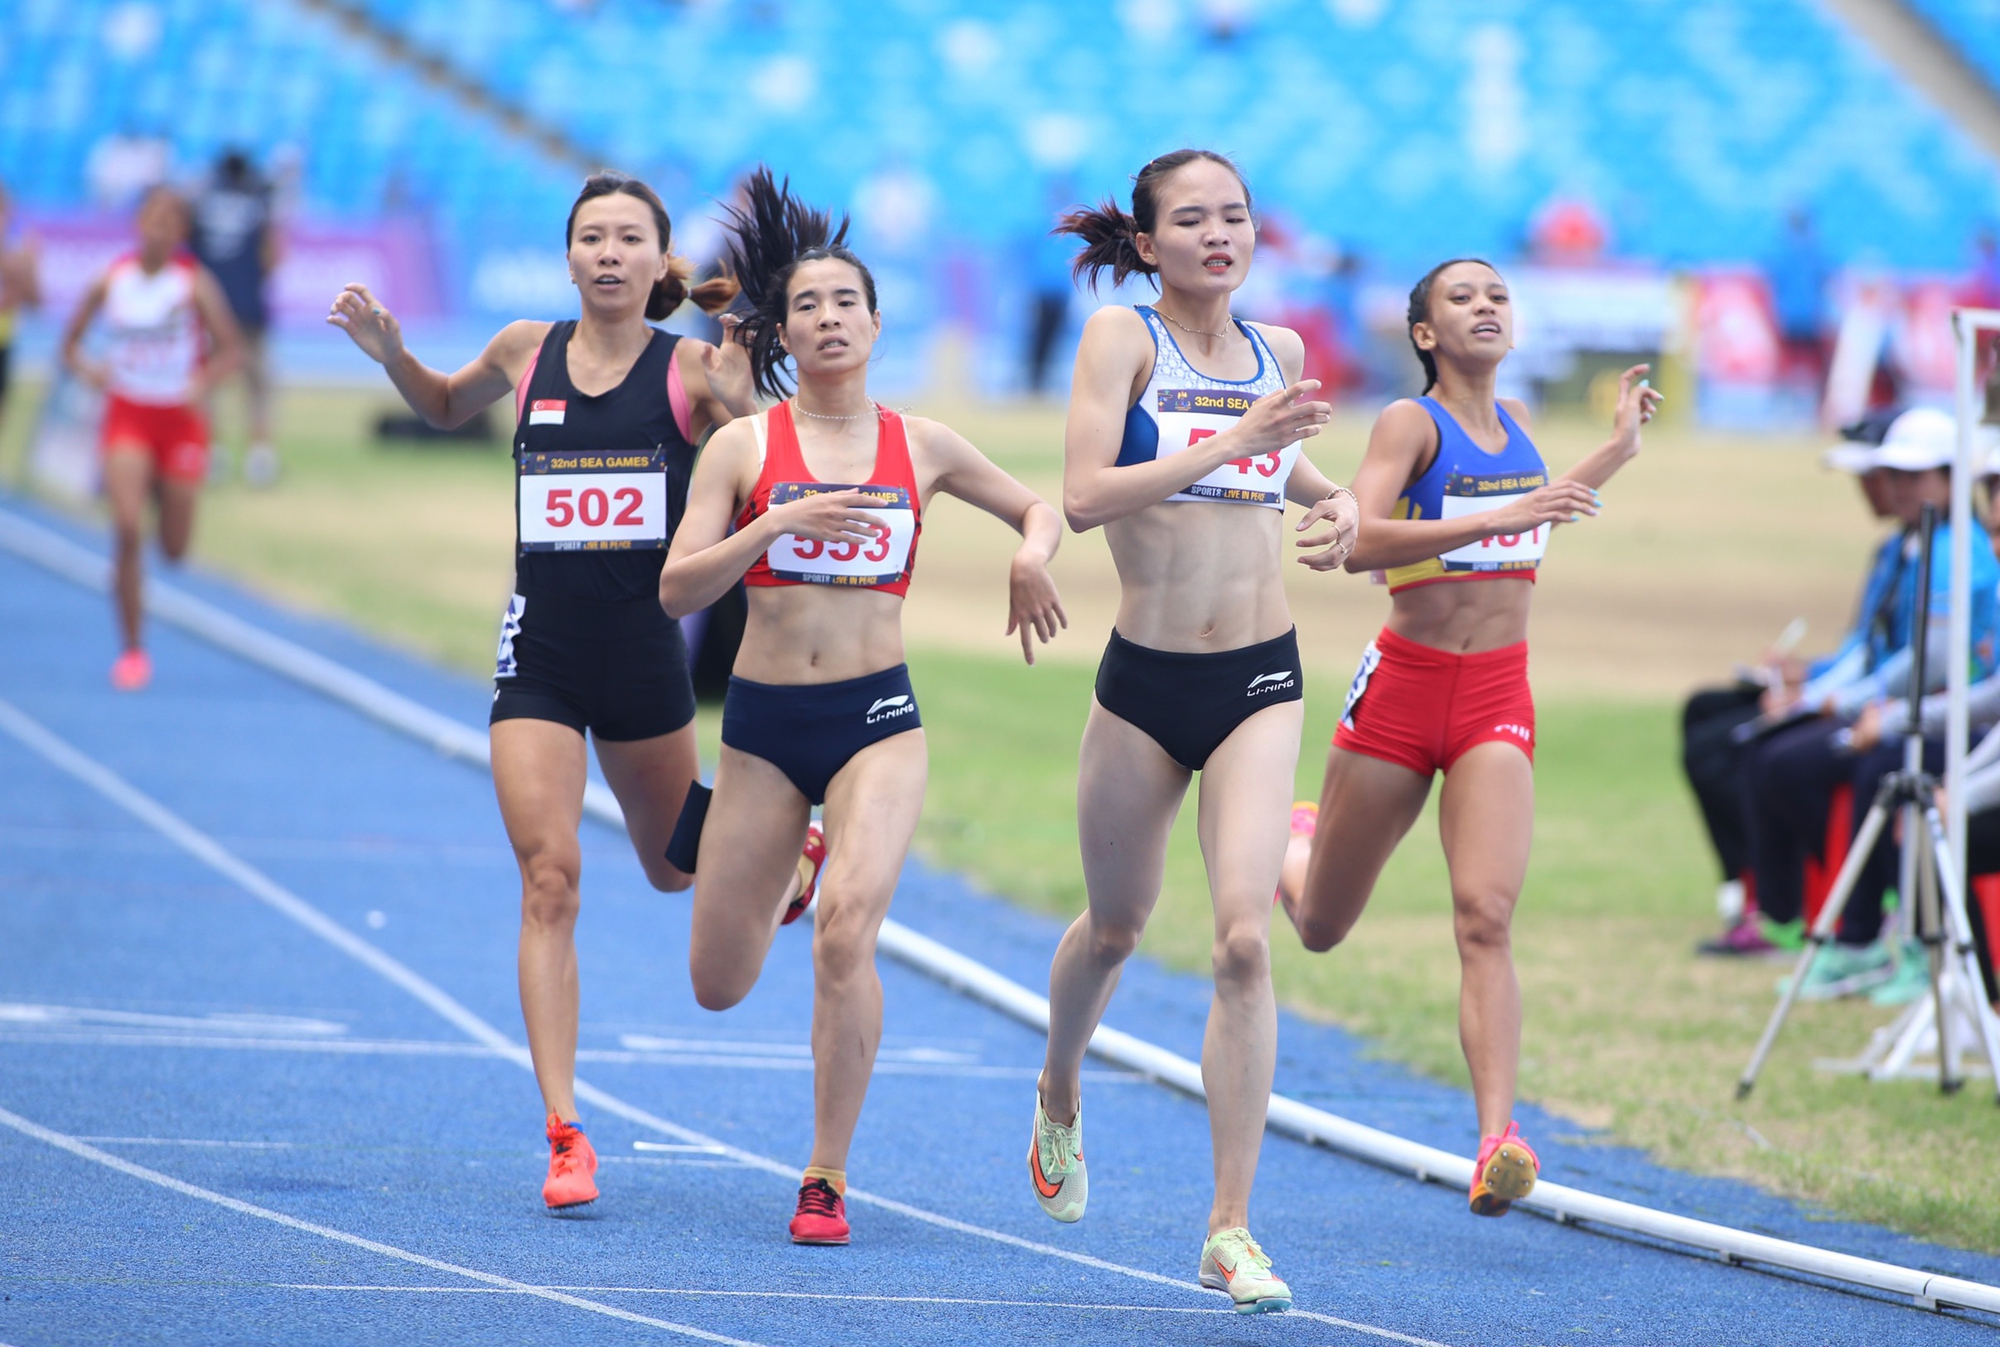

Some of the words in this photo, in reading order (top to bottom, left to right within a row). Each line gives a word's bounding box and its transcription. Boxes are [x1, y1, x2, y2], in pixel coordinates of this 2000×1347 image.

[1194, 396, 1224, 408] 32nd
[1226, 397, 1249, 410] SEA
[550, 458, 577, 469] 32nd
[580, 457, 604, 468] SEA
[606, 456, 649, 468] GAMES
[1477, 480, 1499, 492] 32nd
[1500, 478, 1519, 490] SEA
[1519, 475, 1545, 488] GAMES
[1223, 488, 1240, 499] LIVE
[1241, 490, 1250, 500] IN
[545, 487, 644, 528] 502
[792, 524, 892, 562] 553
[1246, 679, 1294, 697] LI-NING
[866, 703, 914, 724] LI-NING
